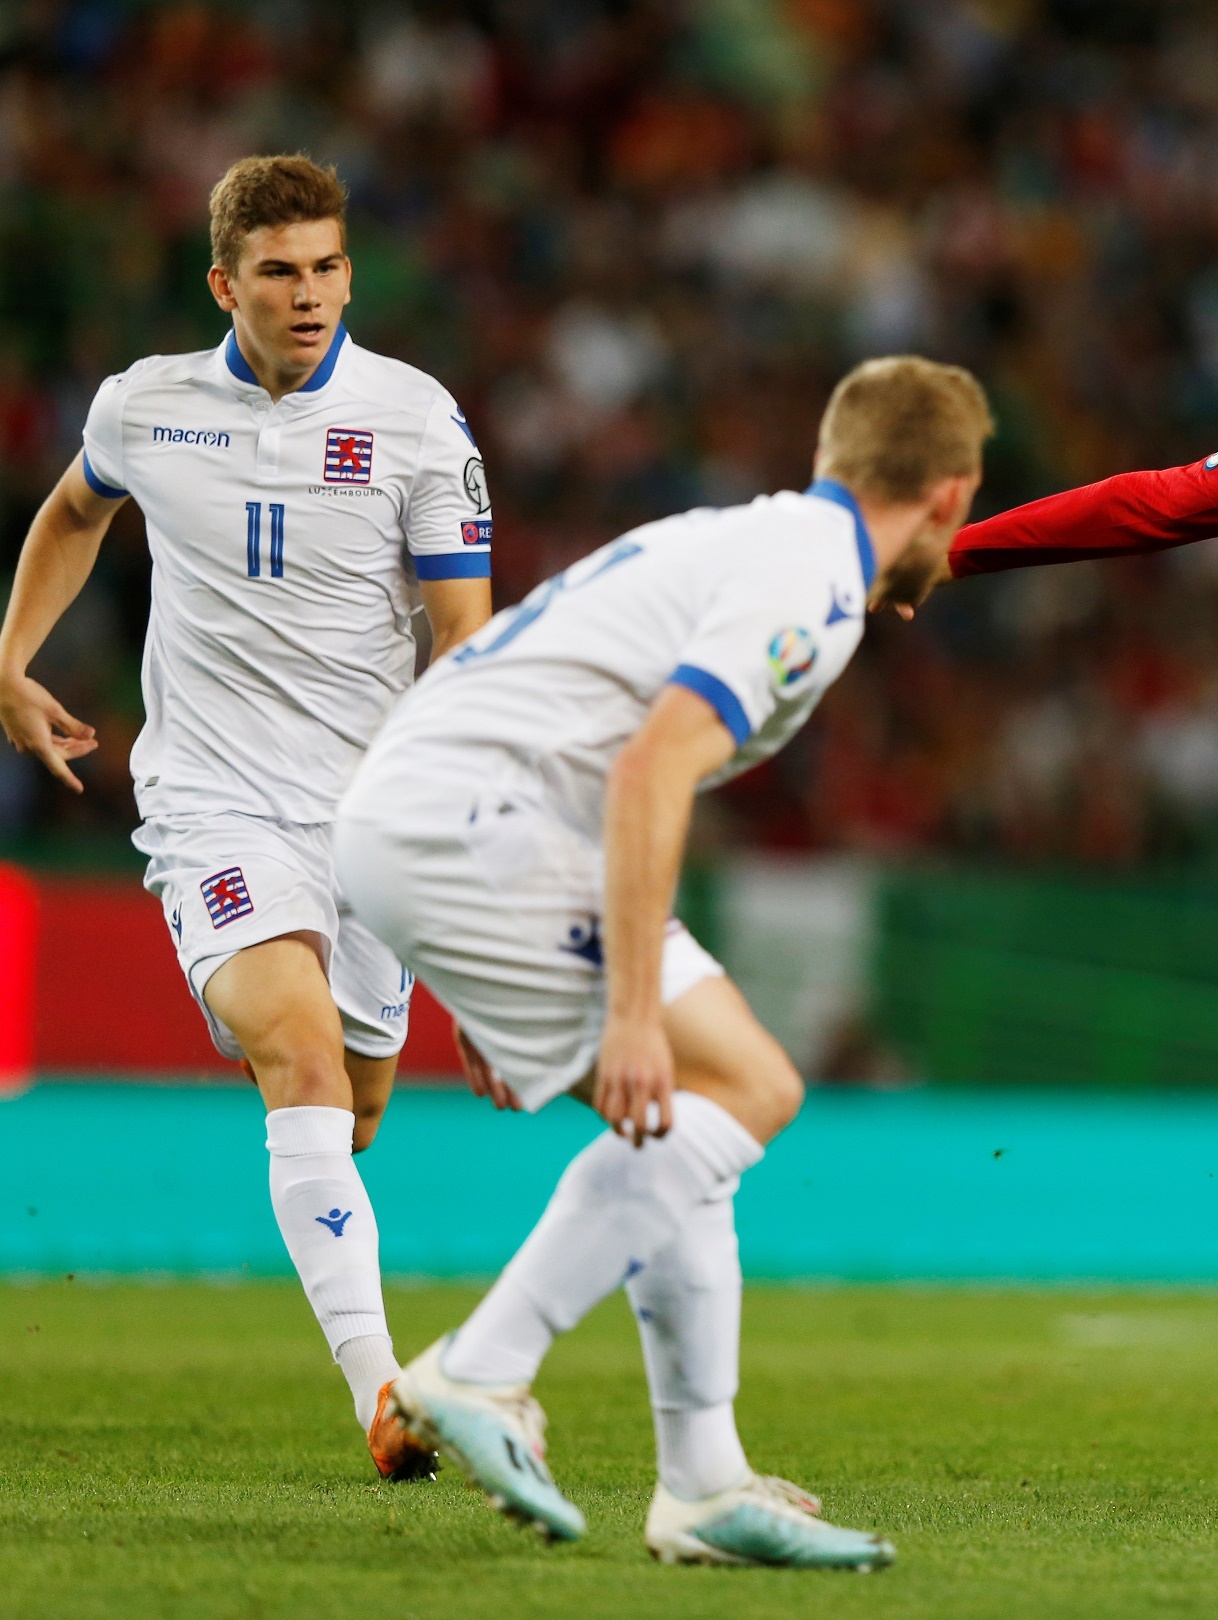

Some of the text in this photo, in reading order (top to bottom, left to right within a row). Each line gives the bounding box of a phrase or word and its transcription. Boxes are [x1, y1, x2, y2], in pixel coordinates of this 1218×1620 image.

[153, 427, 230, 448] macron
[245, 502, 285, 578] 11
[479, 527, 492, 538] RE
